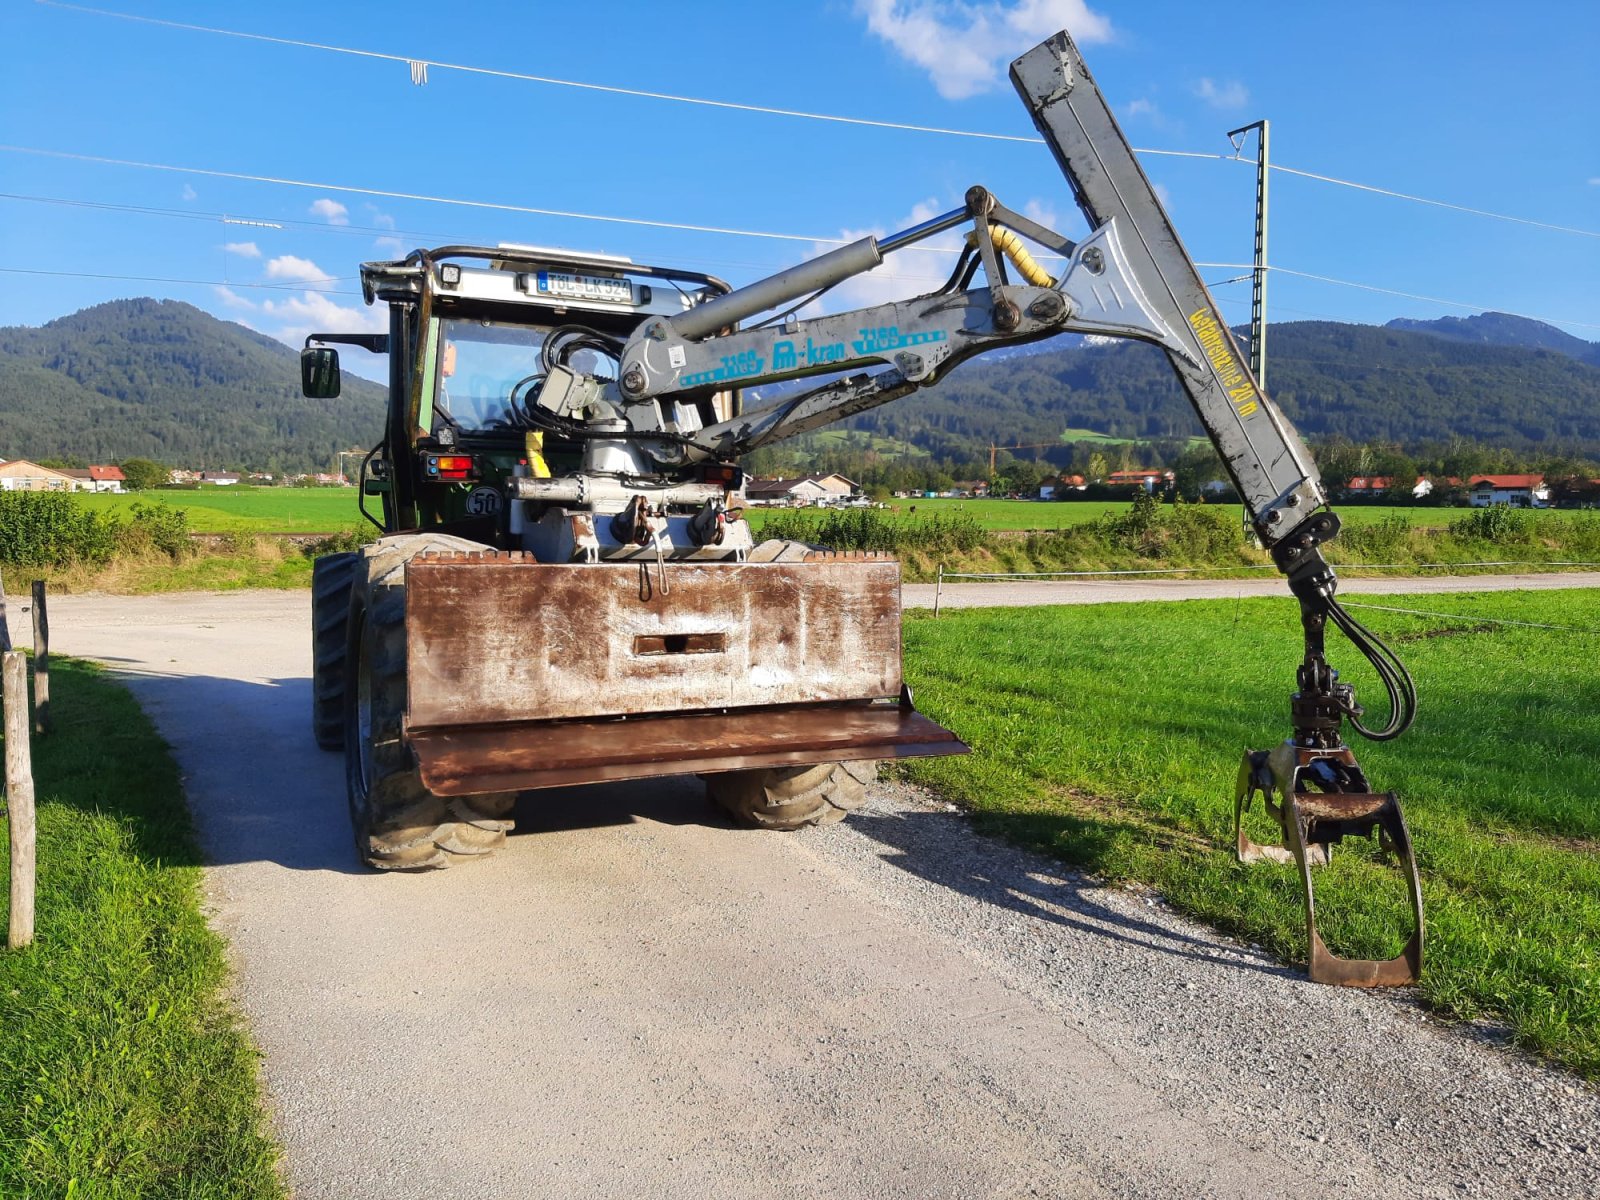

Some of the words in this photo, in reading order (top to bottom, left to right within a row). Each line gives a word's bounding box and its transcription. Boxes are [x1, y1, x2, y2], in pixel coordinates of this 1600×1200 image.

[548, 273, 574, 291] TÖL
[584, 278, 602, 294] LK
[604, 279, 630, 296] 524
[1190, 307, 1243, 387] Gefahrenzone
[1229, 382, 1256, 403] 20
[1238, 401, 1258, 417] m
[474, 493, 496, 515] 50
